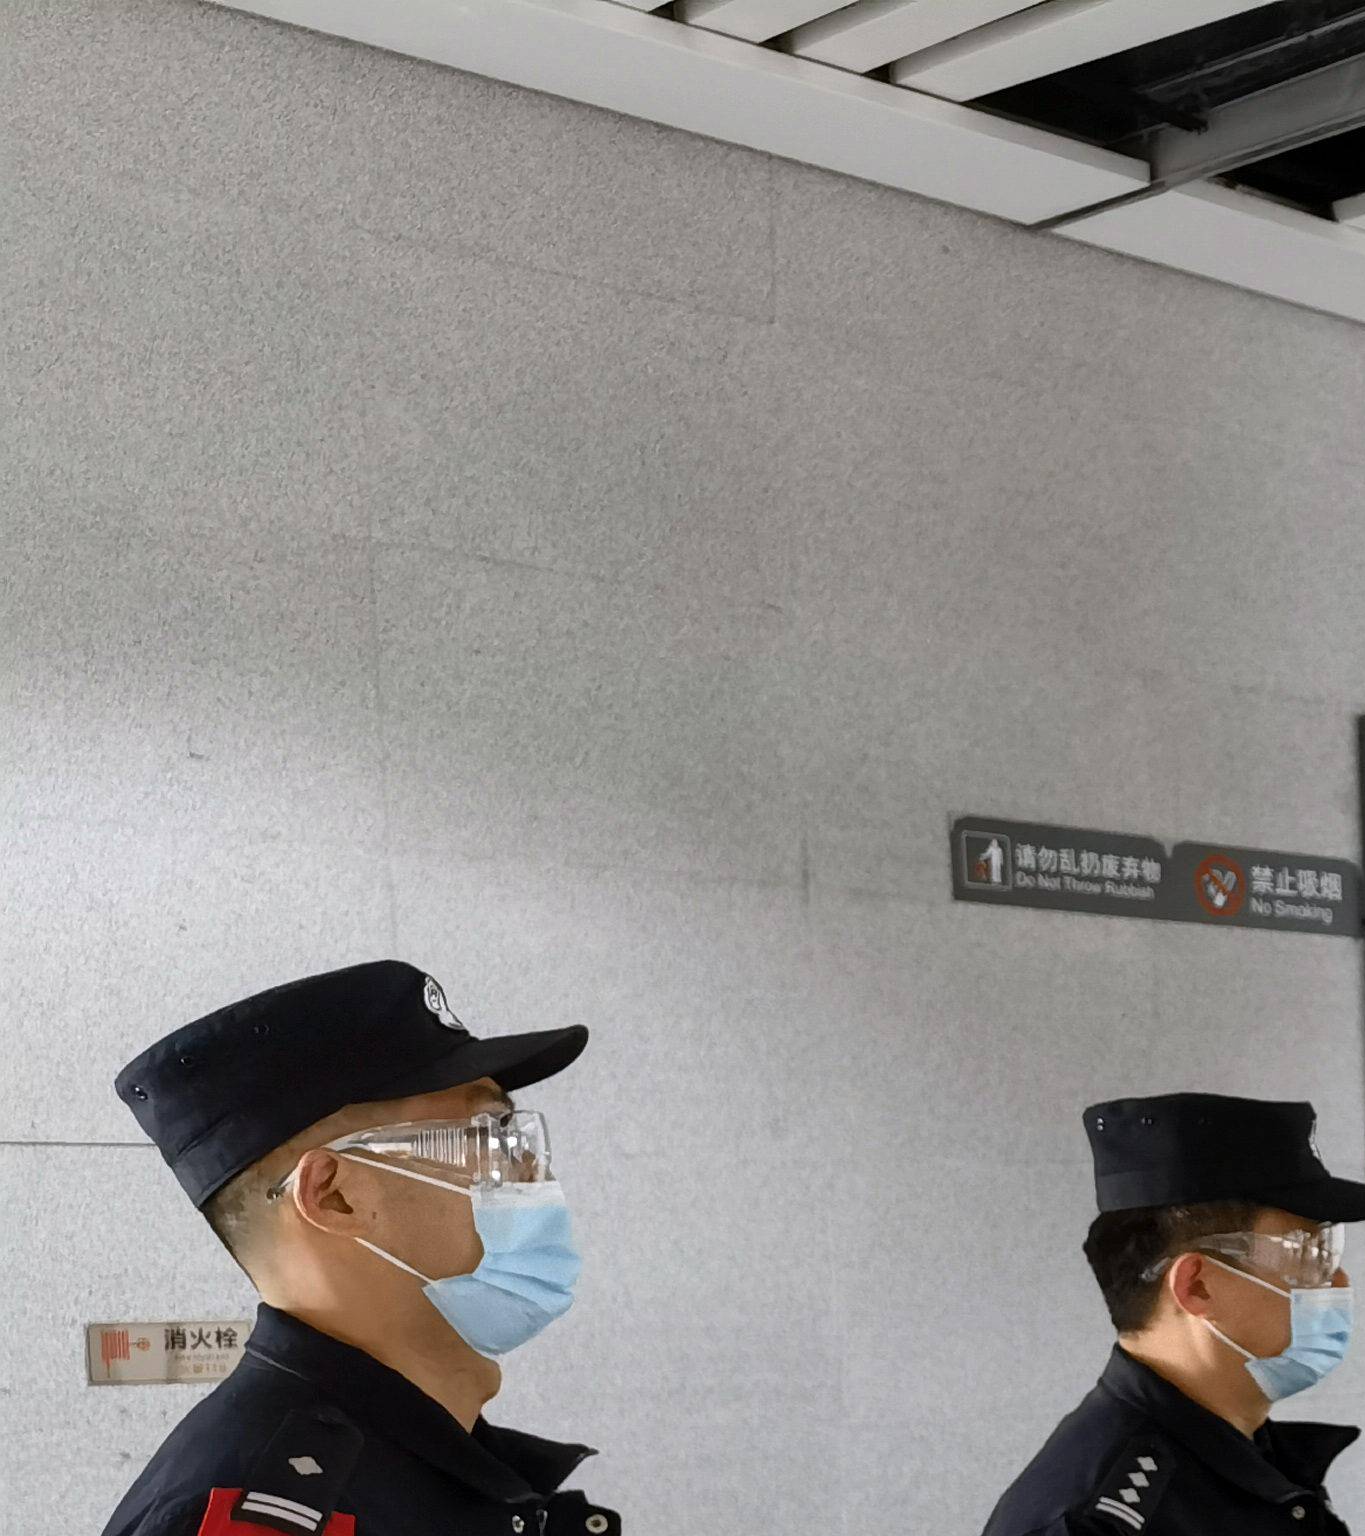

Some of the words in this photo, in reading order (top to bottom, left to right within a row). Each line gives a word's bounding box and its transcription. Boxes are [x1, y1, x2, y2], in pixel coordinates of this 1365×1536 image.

[1015, 843, 1161, 883] 请勿乱扔废弃物
[1015, 871, 1036, 888] Do
[1251, 865, 1342, 900] 禁止吸烟
[1249, 897, 1272, 916] No
[1274, 899, 1333, 926] Smoking
[164, 1326, 238, 1350] 消火栓
